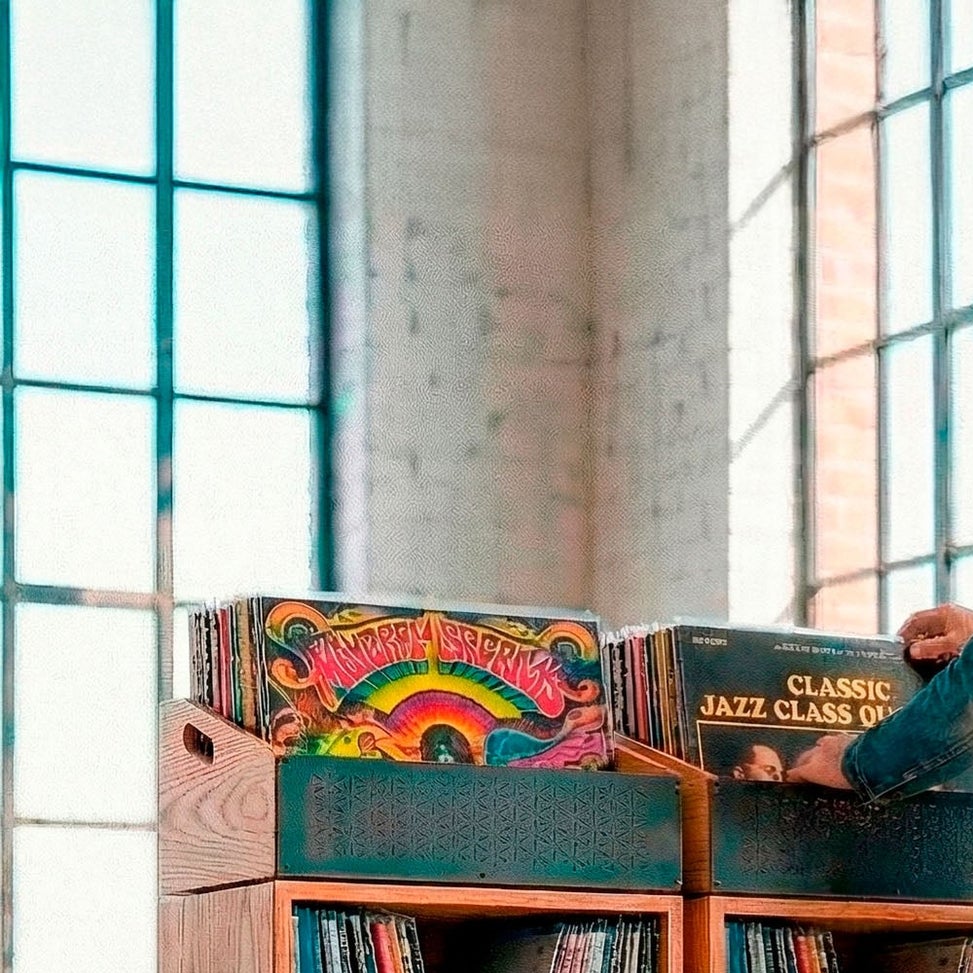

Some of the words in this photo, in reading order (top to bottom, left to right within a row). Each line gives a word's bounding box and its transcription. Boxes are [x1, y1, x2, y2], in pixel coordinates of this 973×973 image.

[786, 674, 891, 702] CLASSIC
[700, 694, 768, 719] JAZZ
[773, 699, 853, 725] CLASS
